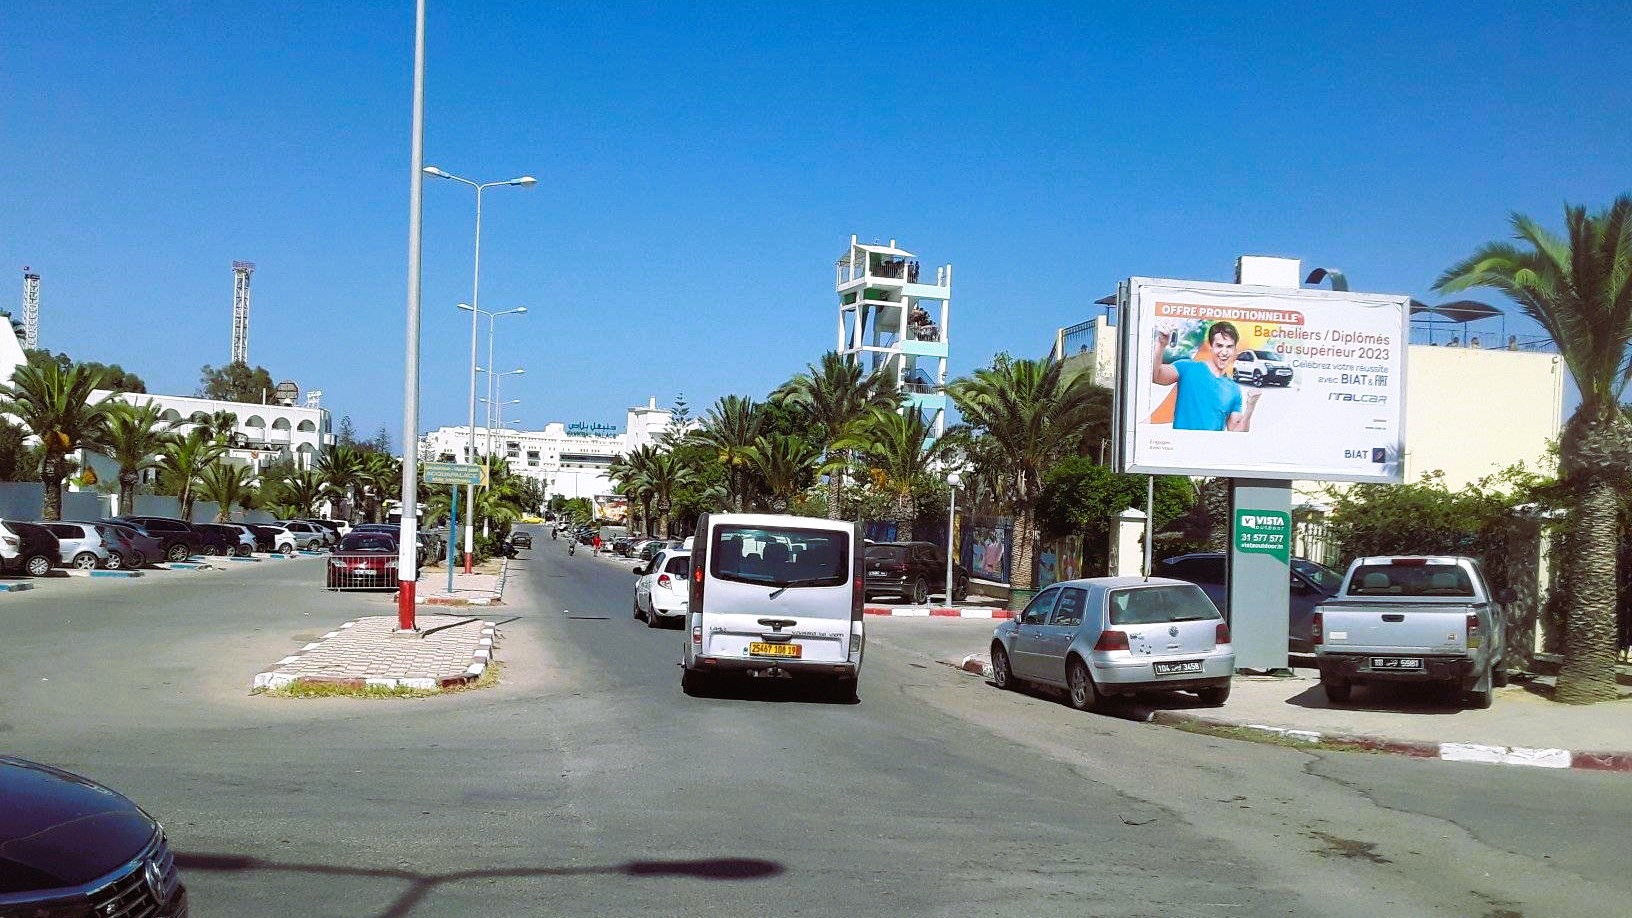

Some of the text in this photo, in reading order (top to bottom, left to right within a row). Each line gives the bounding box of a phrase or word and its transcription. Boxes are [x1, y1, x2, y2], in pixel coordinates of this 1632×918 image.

[1162, 304, 1299, 322] OFFRE PROMOTIONNELLE
[1254, 325, 1390, 345] Bacheliers / Diplômés
[1276, 341, 1390, 360] du supérieur 2023
[1332, 362, 1354, 371] votre
[1317, 376, 1338, 384] avec
[1341, 373, 1367, 386] BIAT
[1344, 450, 1369, 459] BIAT
[1256, 516, 1284, 526] VISTA
[1241, 533, 1284, 542] 31 577 577
